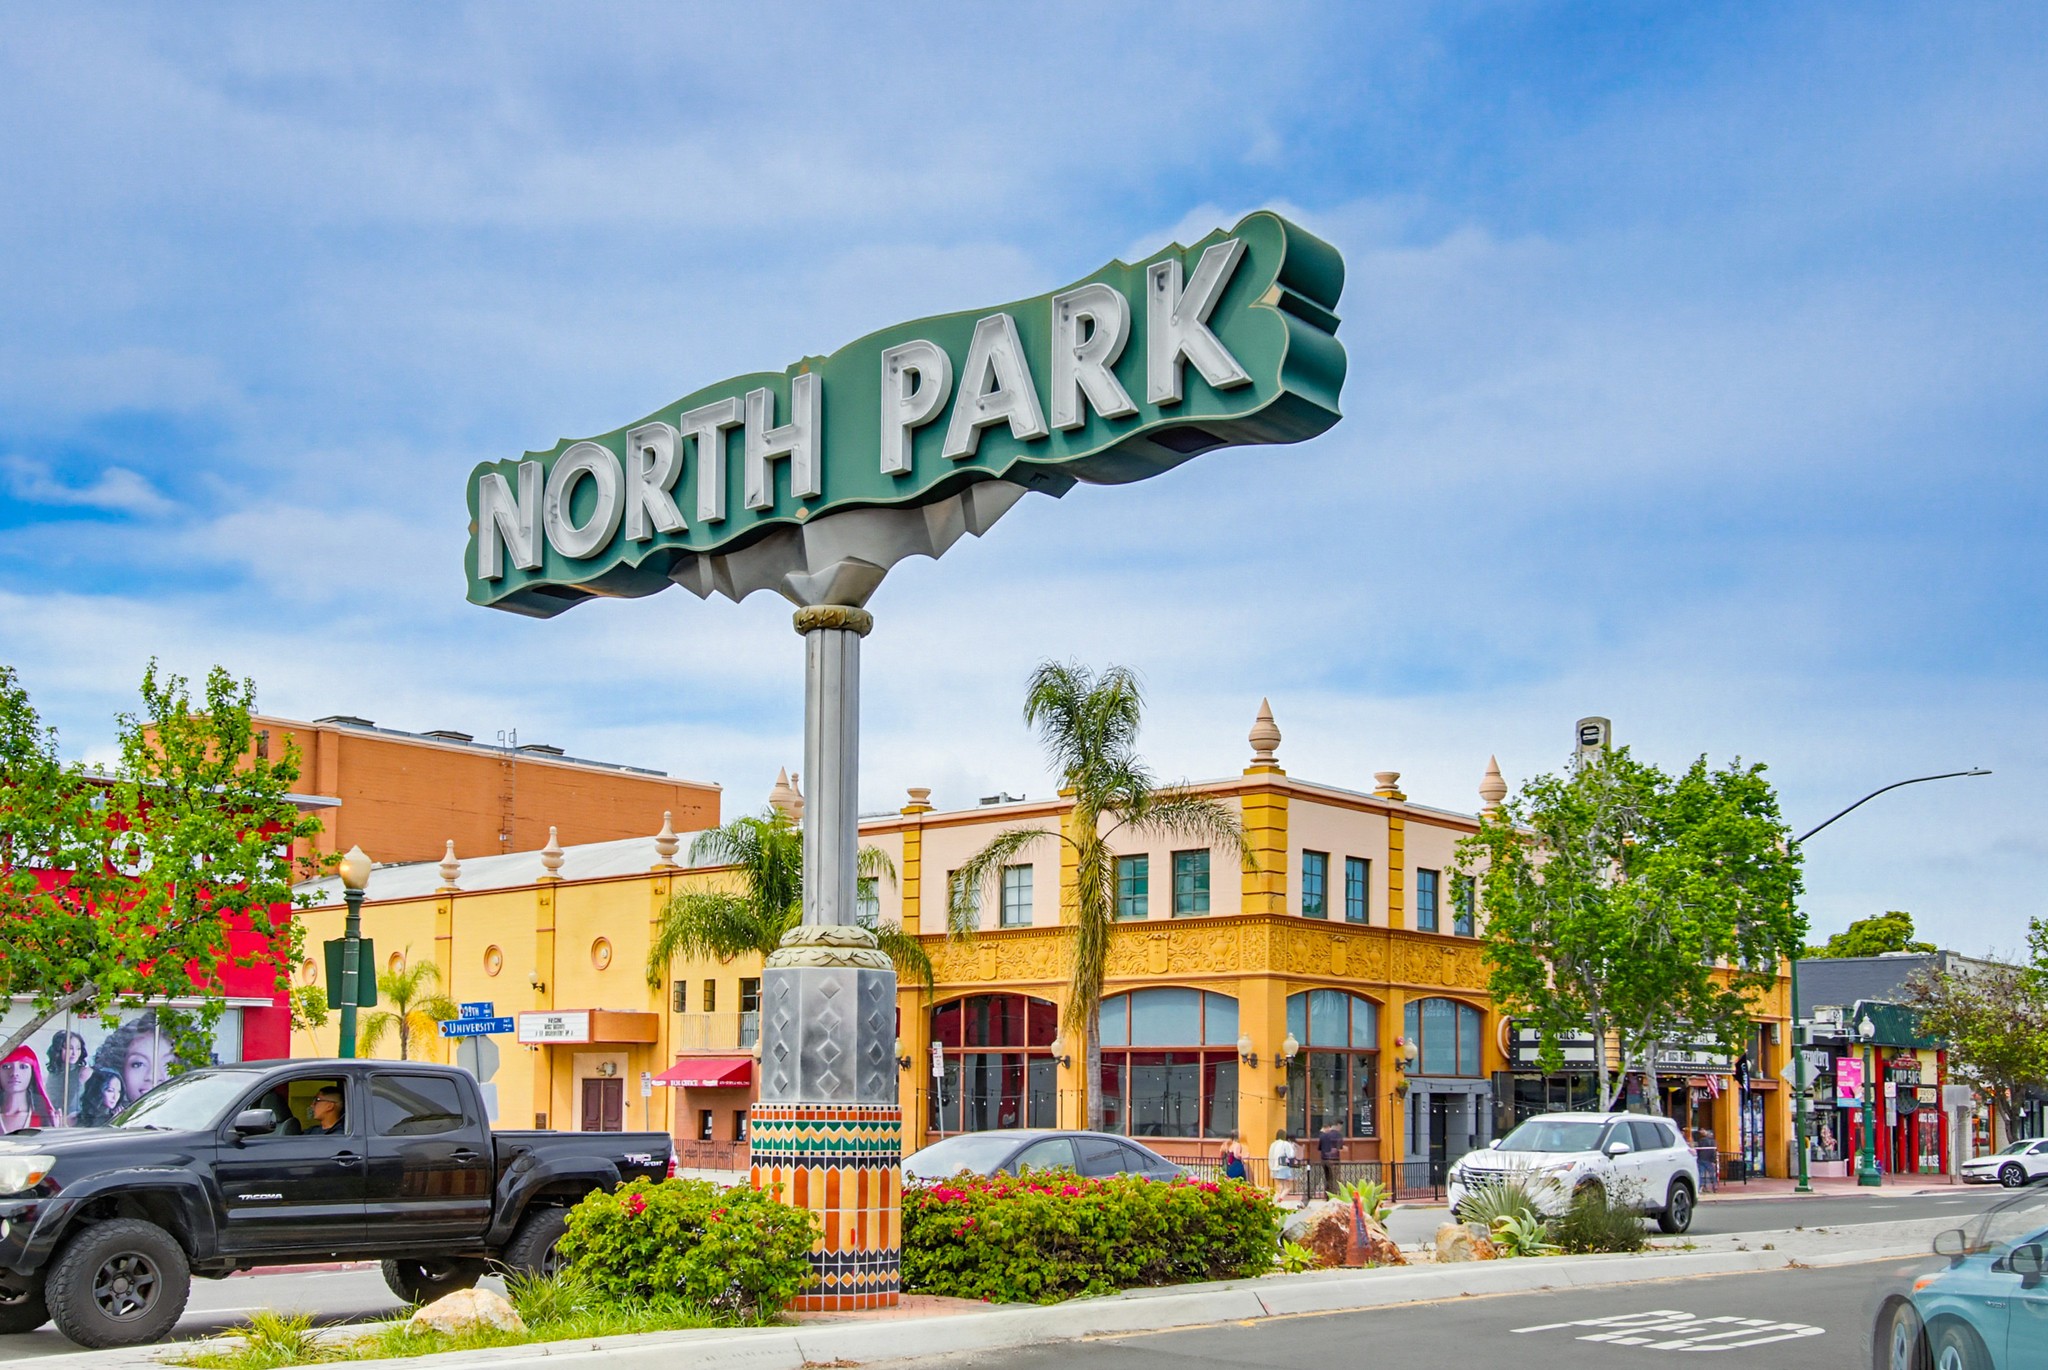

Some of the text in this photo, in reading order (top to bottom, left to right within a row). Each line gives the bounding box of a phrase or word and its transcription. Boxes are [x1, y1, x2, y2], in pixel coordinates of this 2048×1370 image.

[477, 236, 1254, 581] NORTH PARK
[449, 1022, 496, 1034] UNIVERSITY
[1534, 1029, 1575, 1040] CTAILS
[624, 1153, 652, 1164] TRD
